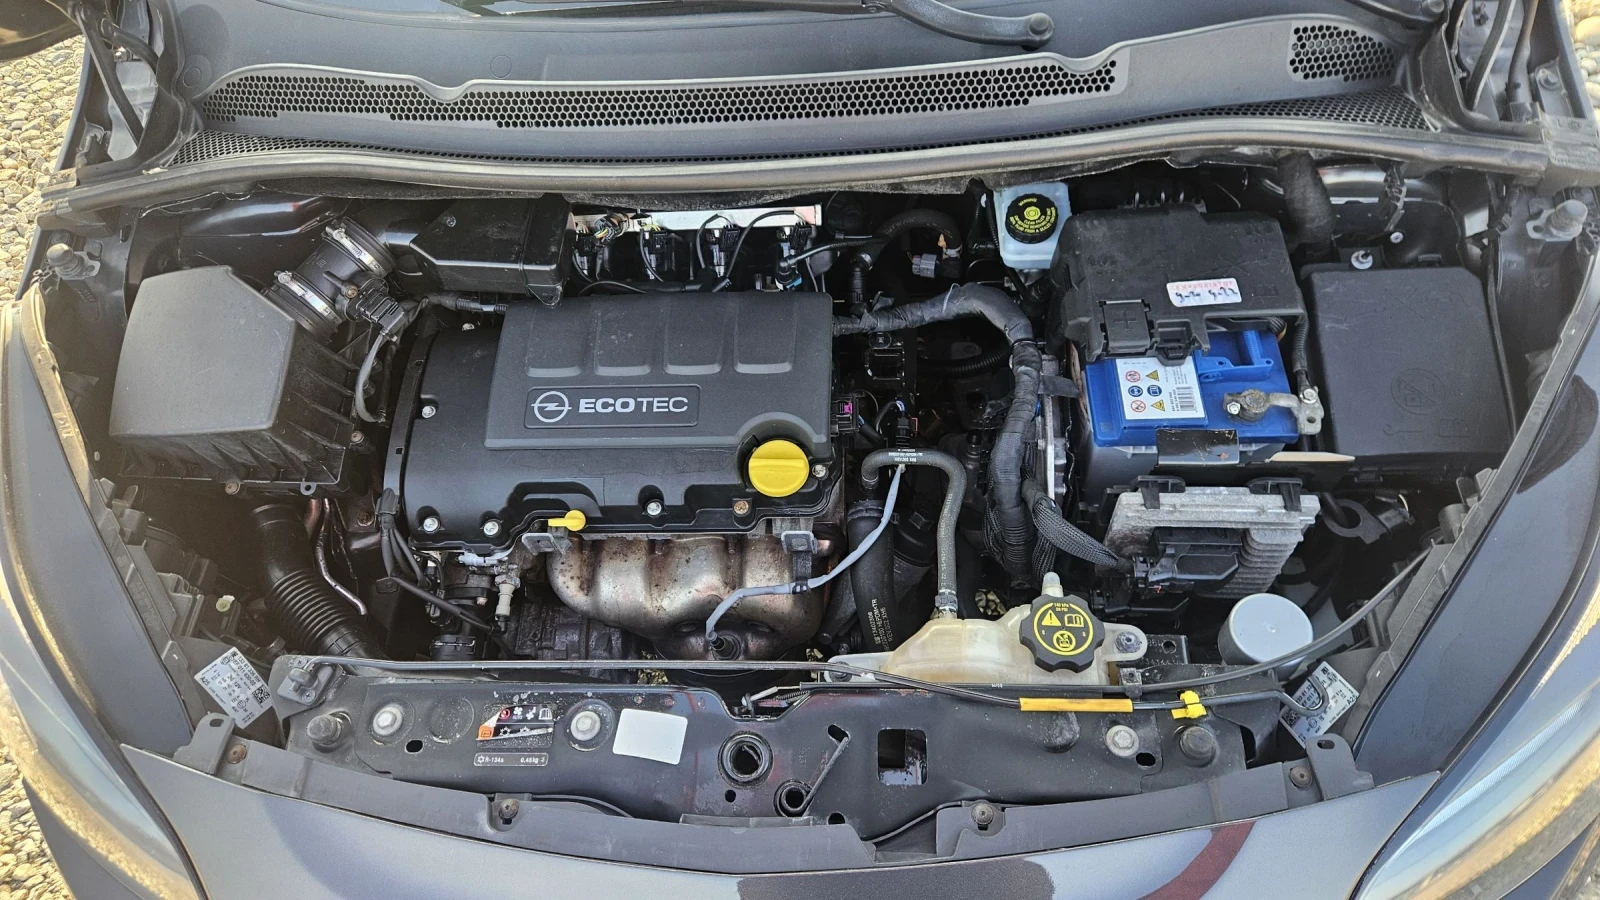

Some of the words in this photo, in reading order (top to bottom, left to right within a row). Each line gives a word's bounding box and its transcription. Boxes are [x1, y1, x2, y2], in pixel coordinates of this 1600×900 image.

[1018, 198, 1037, 206] WARNING
[578, 397, 688, 413] ECOTEC
[200, 676, 210, 686] A25
[234, 681, 242, 689] 12V
